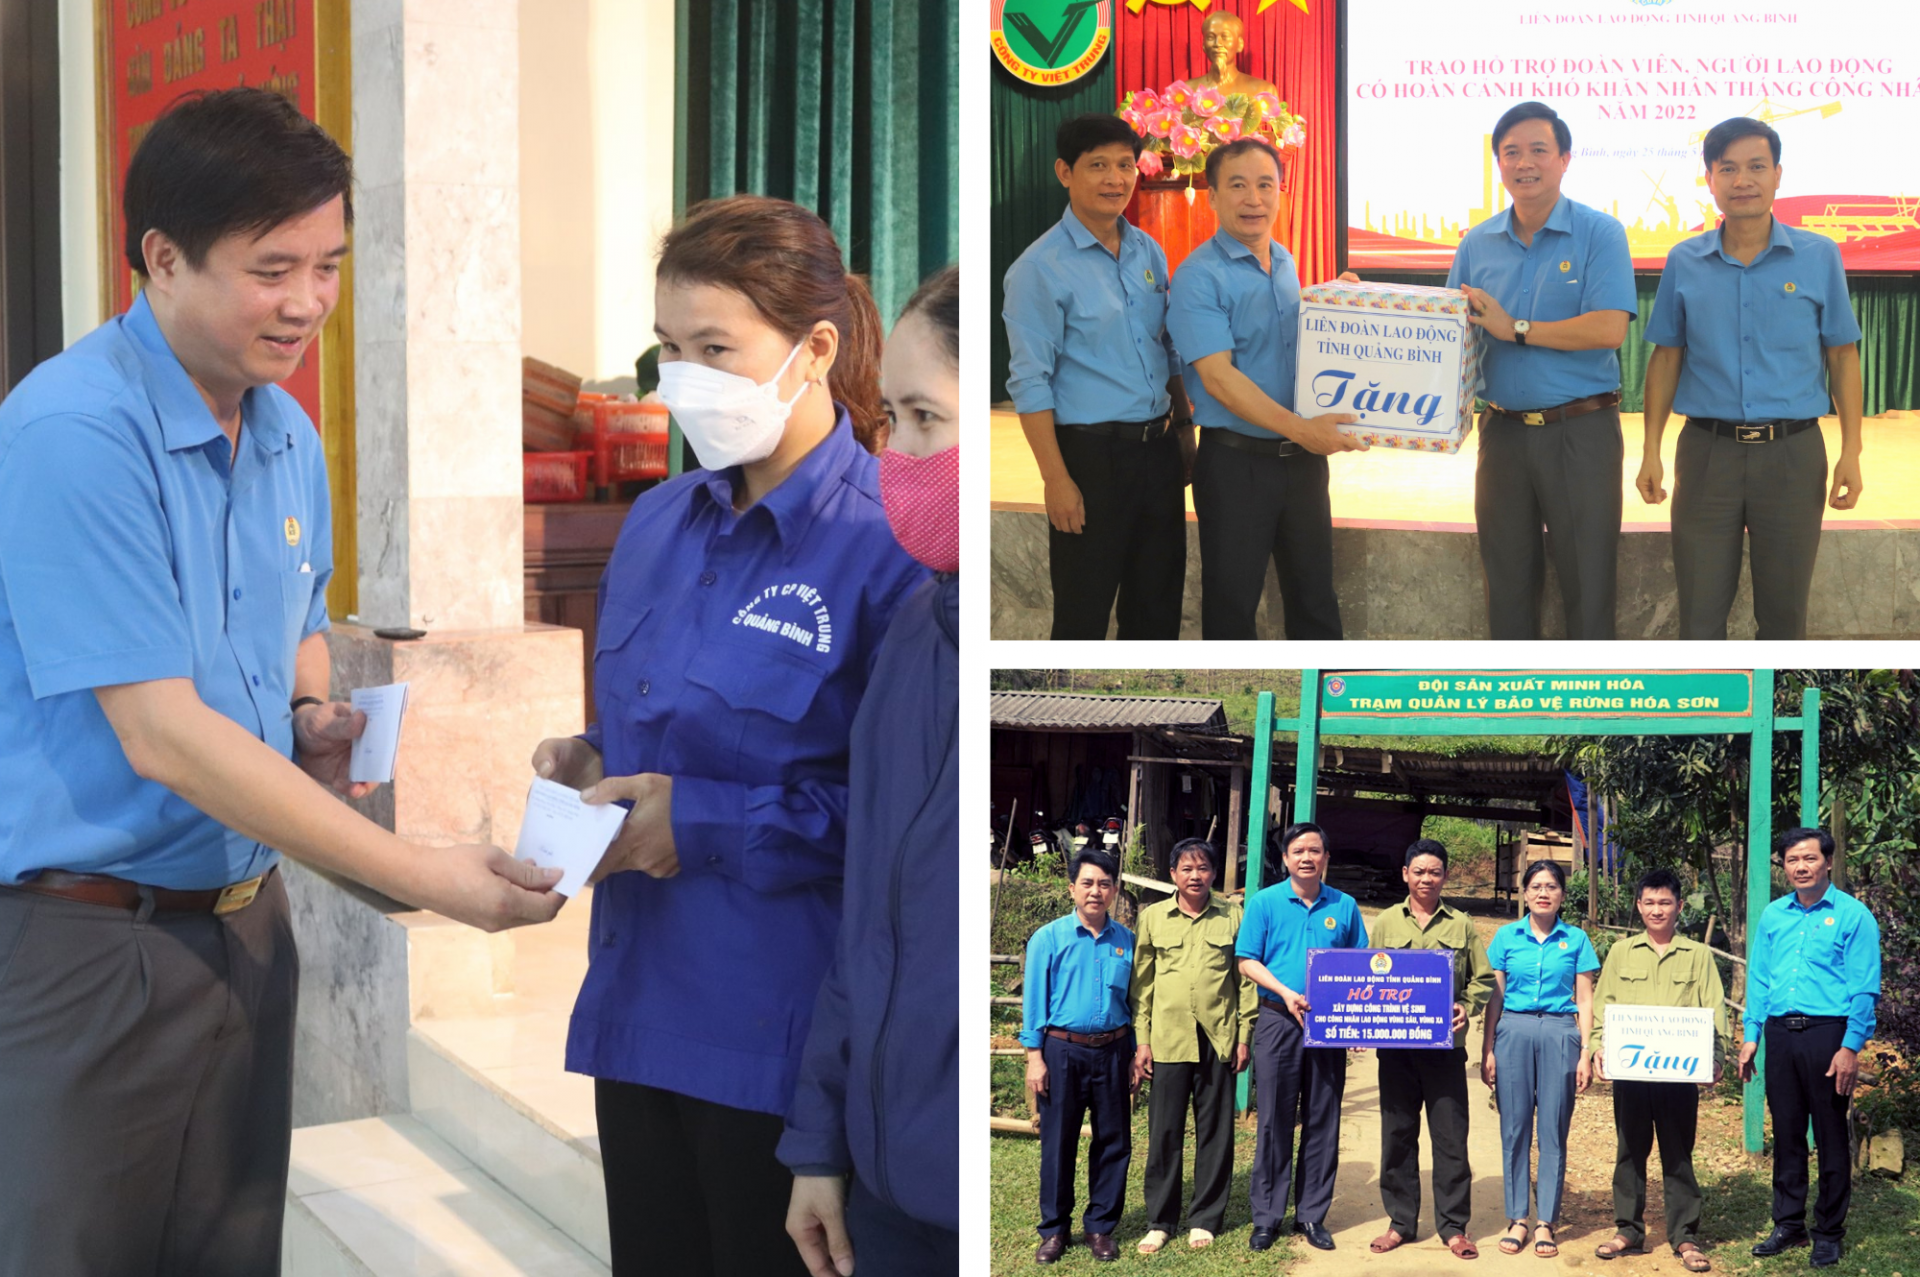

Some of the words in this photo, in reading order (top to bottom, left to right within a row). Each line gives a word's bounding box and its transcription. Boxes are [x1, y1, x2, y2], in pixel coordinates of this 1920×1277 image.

[1598, 14, 1626, 24] LAO
[219, 15, 238, 62] TA
[994, 37, 1020, 71] CÔNG
[1022, 67, 1038, 80] TY
[1041, 70, 1070, 83] VIỆT
[1072, 34, 1107, 74] TRUNG
[1405, 59, 1466, 75] TRAO
[1510, 57, 1557, 79] TRỢ
[1563, 54, 1624, 74] ĐOÀN
[1631, 53, 1690, 75] VIÊN,
[1696, 54, 1769, 74] NGƯỜI
[1777, 58, 1822, 74] LAO
[1829, 55, 1892, 79] ĐỘNG
[1356, 79, 1387, 99] CÓ
[1394, 78, 1455, 98] HOÀN
[1462, 78, 1523, 98] CẢNH
[1532, 77, 1580, 98] KHÓ
[1587, 78, 1648, 98] KHĂN
[1656, 76, 1717, 97] NHÂN
[1724, 76, 1802, 97] THÁNG
[1809, 76, 1873, 97] CÔNG
[1598, 101, 1647, 120] NĂM
[1654, 104, 1696, 120] 2022
[1642, 147, 1654, 157] 25
[1305, 316, 1337, 333] LIÊN
[1340, 319, 1380, 336] ĐOÀN
[1383, 324, 1413, 339] LAO
[1416, 325, 1457, 344] ĐỘNG
[1317, 338, 1350, 356] TỈNH
[1354, 342, 1404, 361] QUẢNG
[1407, 346, 1442, 363] BÌNH
[1311, 369, 1444, 426] Tặng
[732, 595, 761, 625] CÔNG
[764, 585, 778, 599] TY
[781, 583, 798, 596] CP
[796, 583, 822, 606] VIỆT
[814, 605, 832, 653] TRUNG
[743, 613, 781, 633] QUẢNG
[780, 622, 814, 647] BÌNH
[1418, 679, 1449, 693] ĐỘI
[1454, 678, 1492, 691] SẢN
[1498, 677, 1545, 691] XUẤT
[1550, 680, 1600, 690] MINH
[1606, 678, 1645, 690] HÓA
[1349, 698, 1402, 711] TRẠM
[1408, 695, 1460, 710] QUẢN
[1466, 696, 1488, 709] LÝ
[1494, 695, 1533, 709] BẢO
[1539, 696, 1563, 711] VỆ
[1569, 695, 1624, 709] RỪNG
[1630, 696, 1671, 709] HÓA
[1677, 696, 1719, 709] SƠN
[1347, 985, 1375, 1001] HỖ
[1379, 988, 1413, 1003] TRỢ
[1332, 1002, 1345, 1013] XÂY
[1314, 1015, 1326, 1023] CHO
[1435, 1016, 1443, 1024] XA
[1325, 1025, 1337, 1039] SỐ
[1362, 1028, 1407, 1039] 15.000.000
[1618, 1044, 1701, 1077] Tặng
